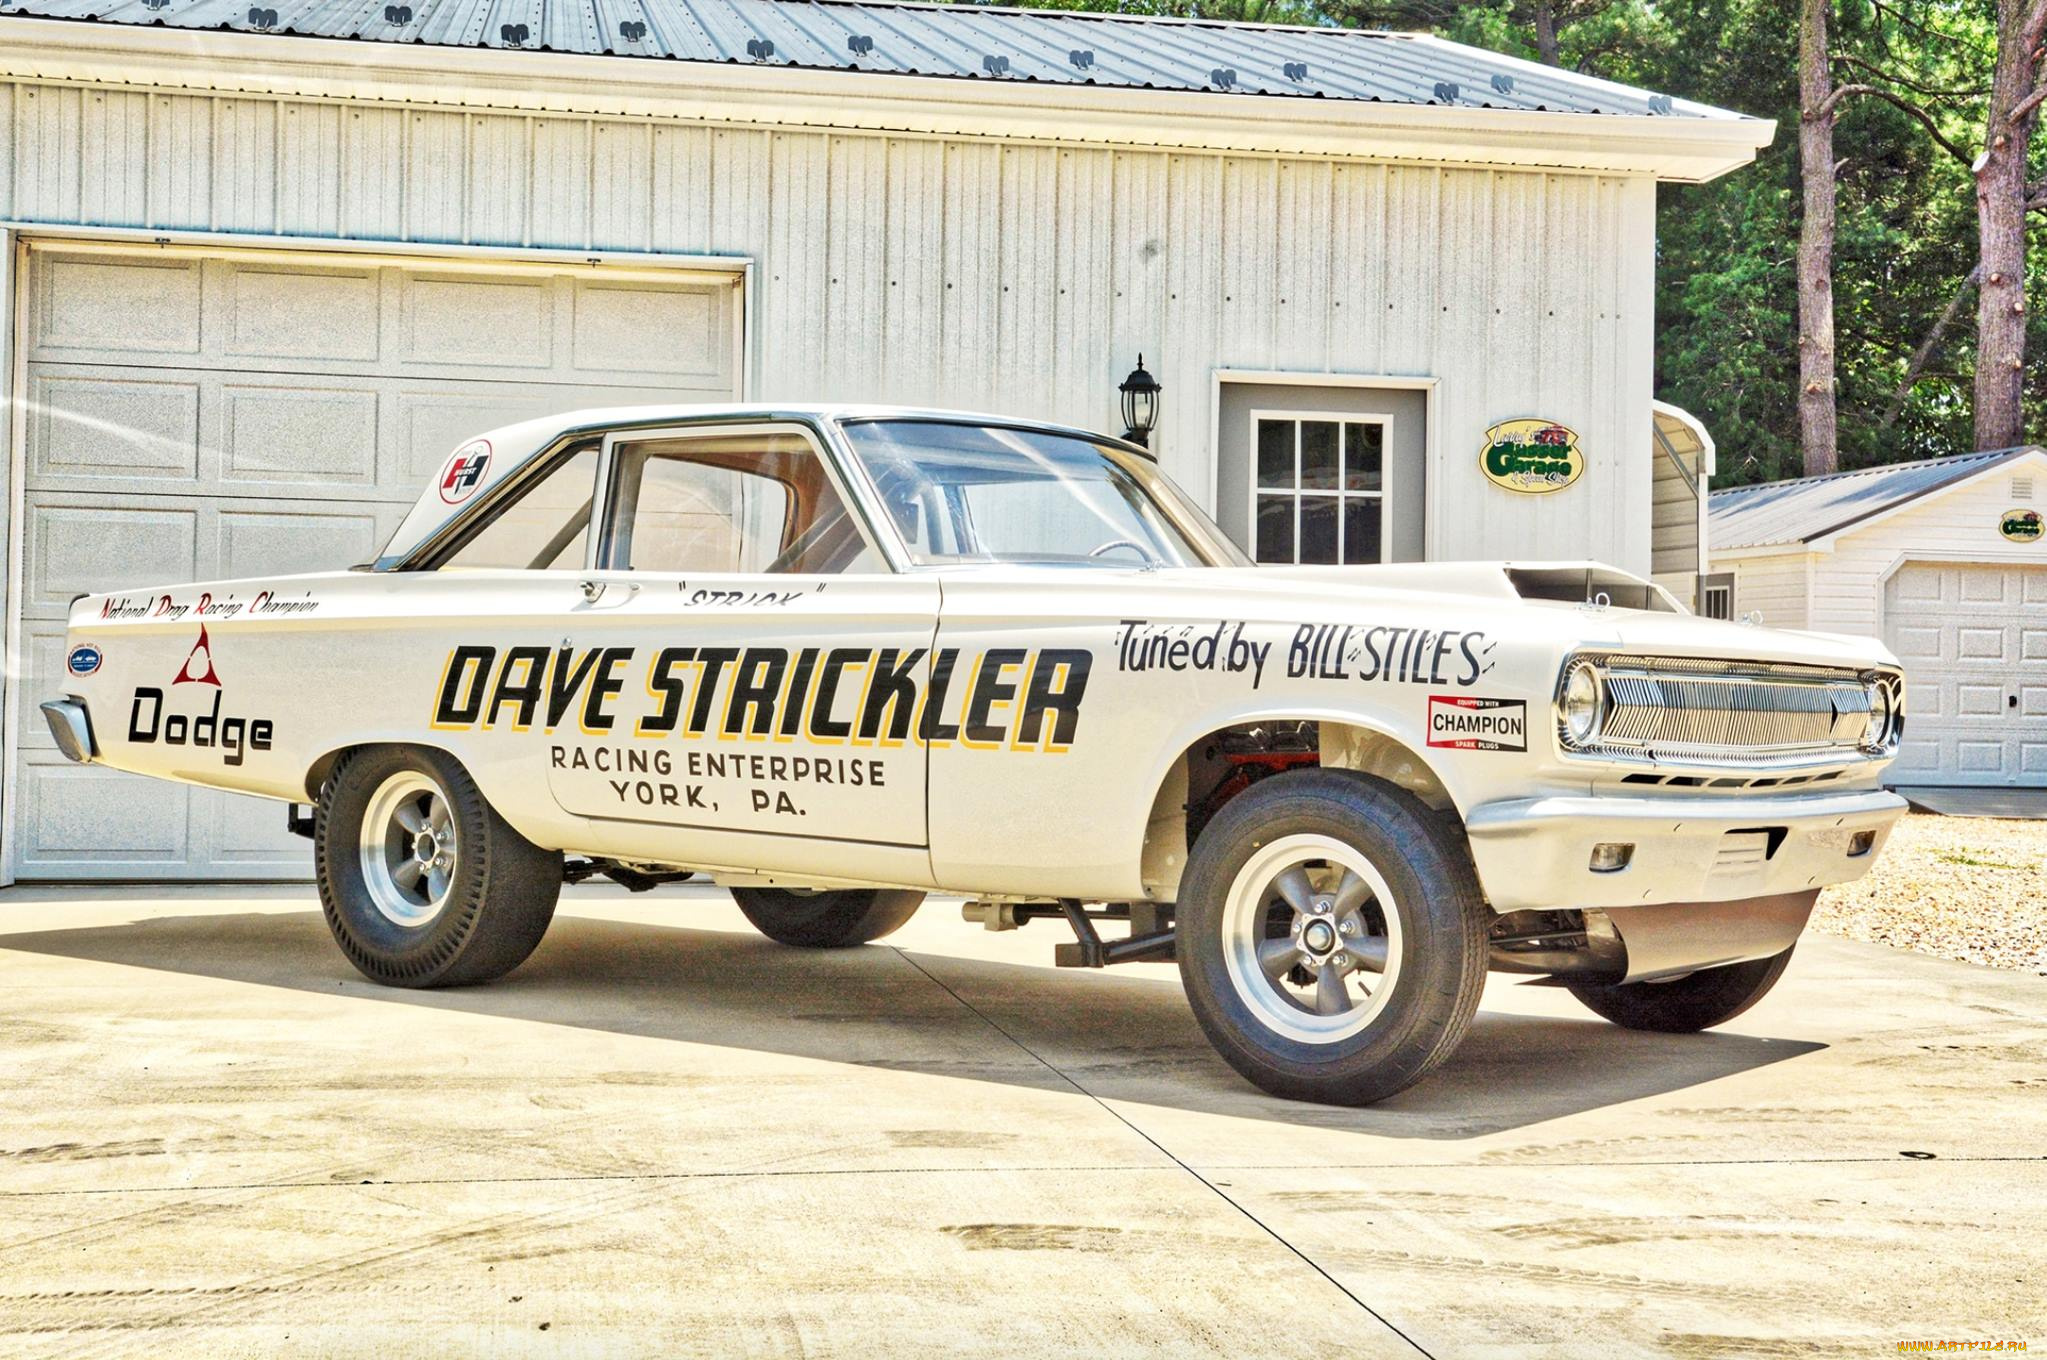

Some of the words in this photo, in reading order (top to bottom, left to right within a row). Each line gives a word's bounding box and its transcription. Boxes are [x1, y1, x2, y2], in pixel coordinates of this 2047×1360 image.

[101, 596, 154, 619] National
[153, 594, 190, 621] Drag
[193, 592, 243, 619] Racing
[249, 591, 319, 616] Champion
[1119, 619, 1227, 672] Tuned
[1227, 622, 1272, 689] by
[1287, 624, 1354, 680] BILL
[1359, 627, 1486, 686] STILES
[430, 646, 635, 734] DAVE
[634, 647, 1095, 753] STRICKLER
[1433, 714, 1522, 735] CHAMPION
[128, 686, 273, 766] Dodge
[551, 745, 673, 776] RACING
[688, 752, 886, 787] ENTERPRISE
[609, 779, 719, 812] YORK,
[750, 787, 806, 816] PA.
